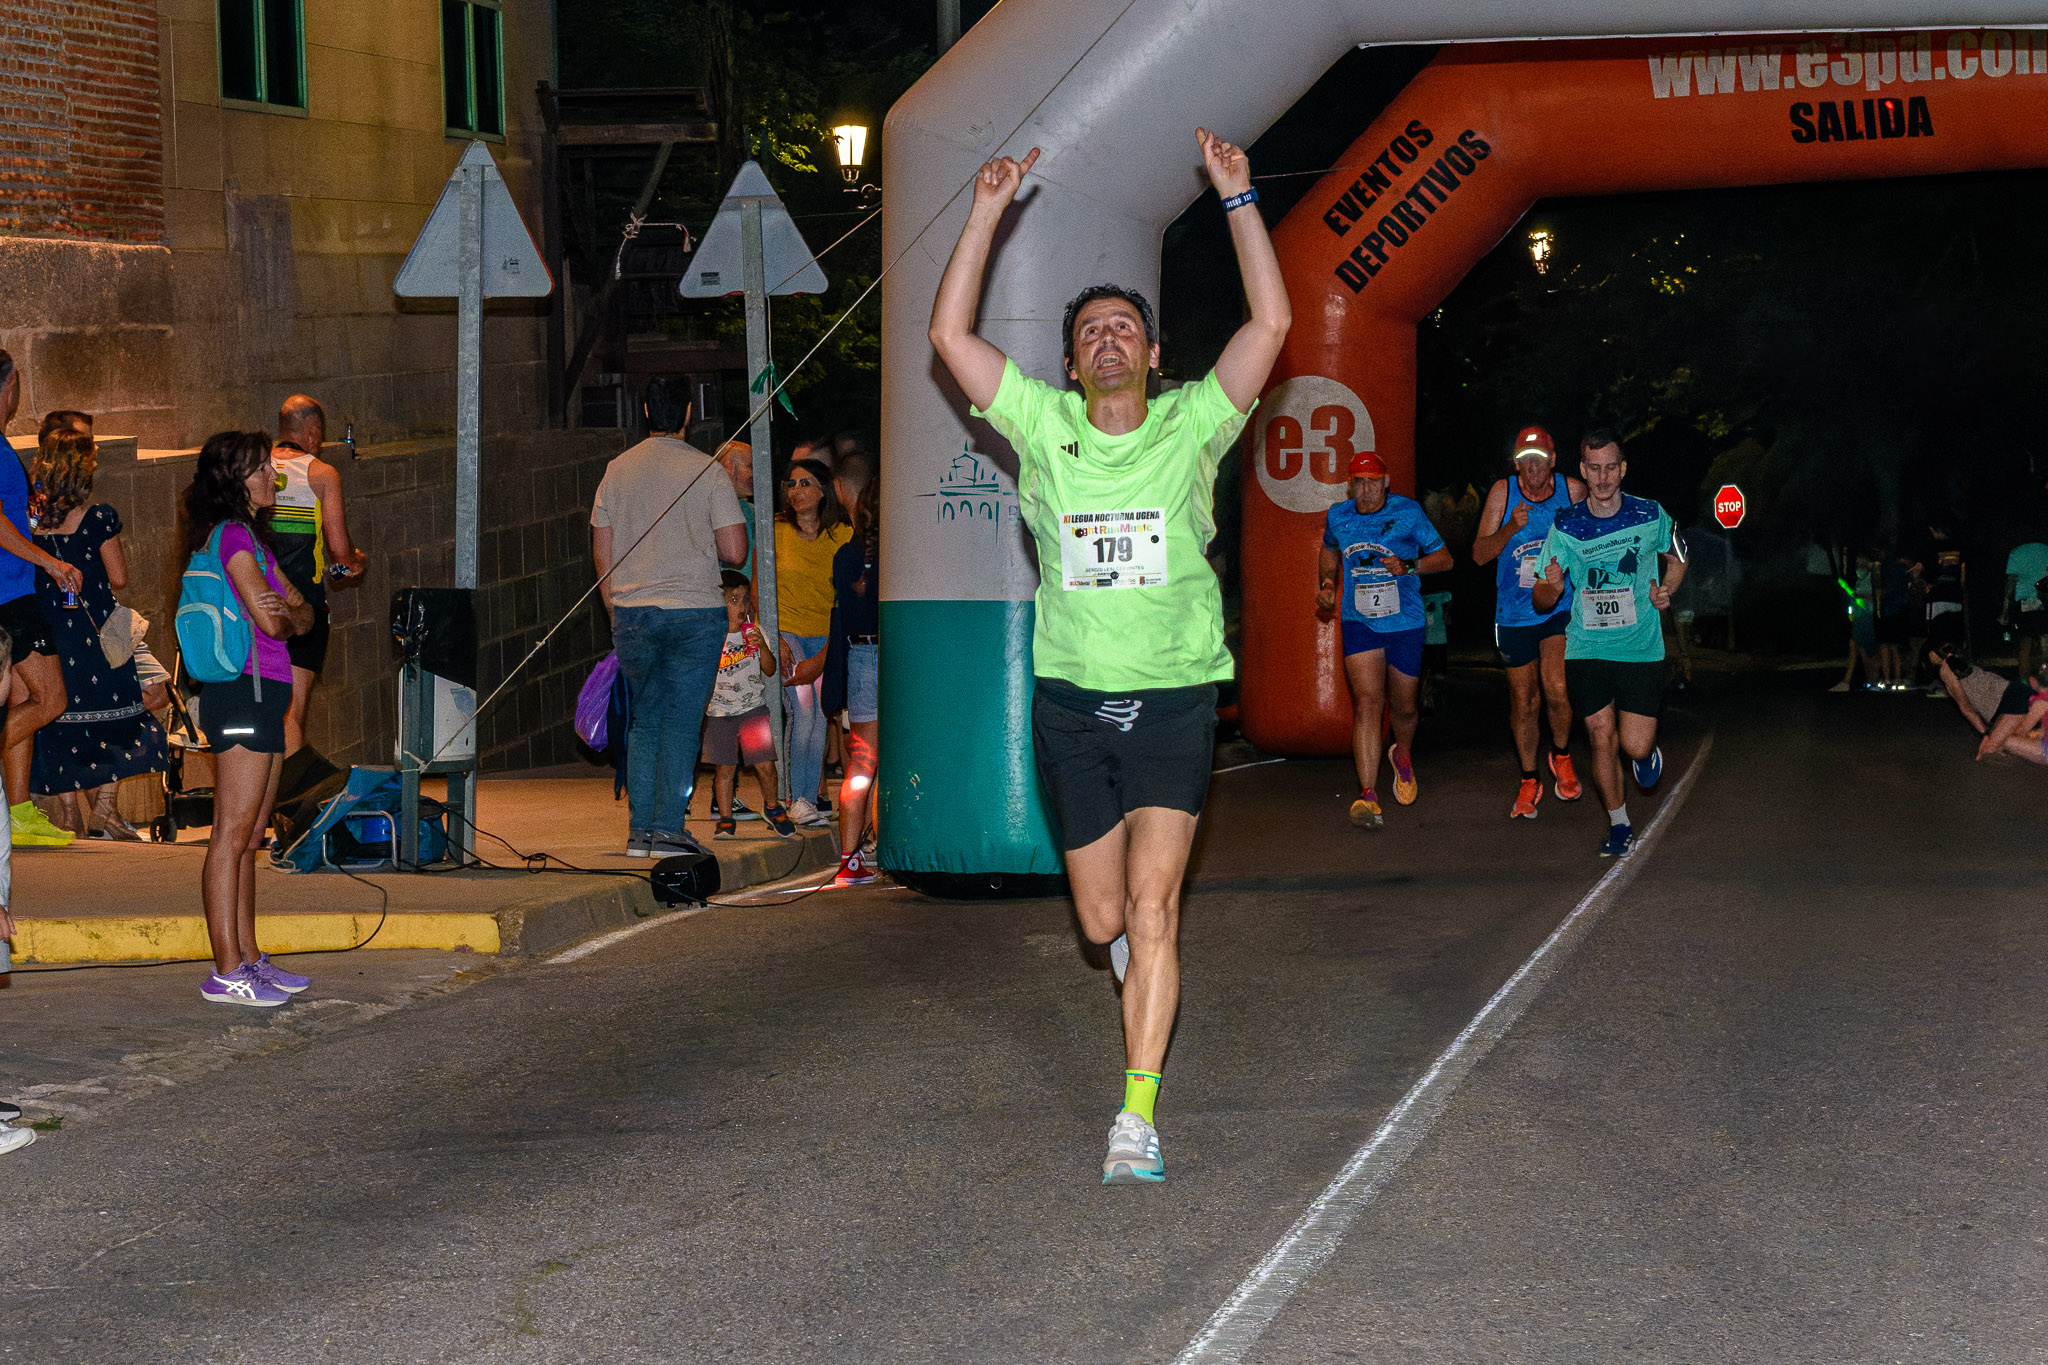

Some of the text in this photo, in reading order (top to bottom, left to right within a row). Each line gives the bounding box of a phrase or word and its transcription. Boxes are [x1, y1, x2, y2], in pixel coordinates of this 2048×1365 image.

[1789, 96, 1935, 144] SALIDA
[1322, 119, 1434, 238] EVENTOS
[1334, 129, 1492, 294] DEPORTIVOS
[1265, 404, 1355, 485] e3
[1071, 514, 1094, 523] LEGUA
[1094, 512, 1135, 522] NOCTURNA
[1135, 511, 1160, 520] UGENA
[1718, 501, 1742, 513] STOP
[1092, 536, 1133, 563] 179
[1373, 594, 1381, 606] 2
[1595, 600, 1620, 615] 320
